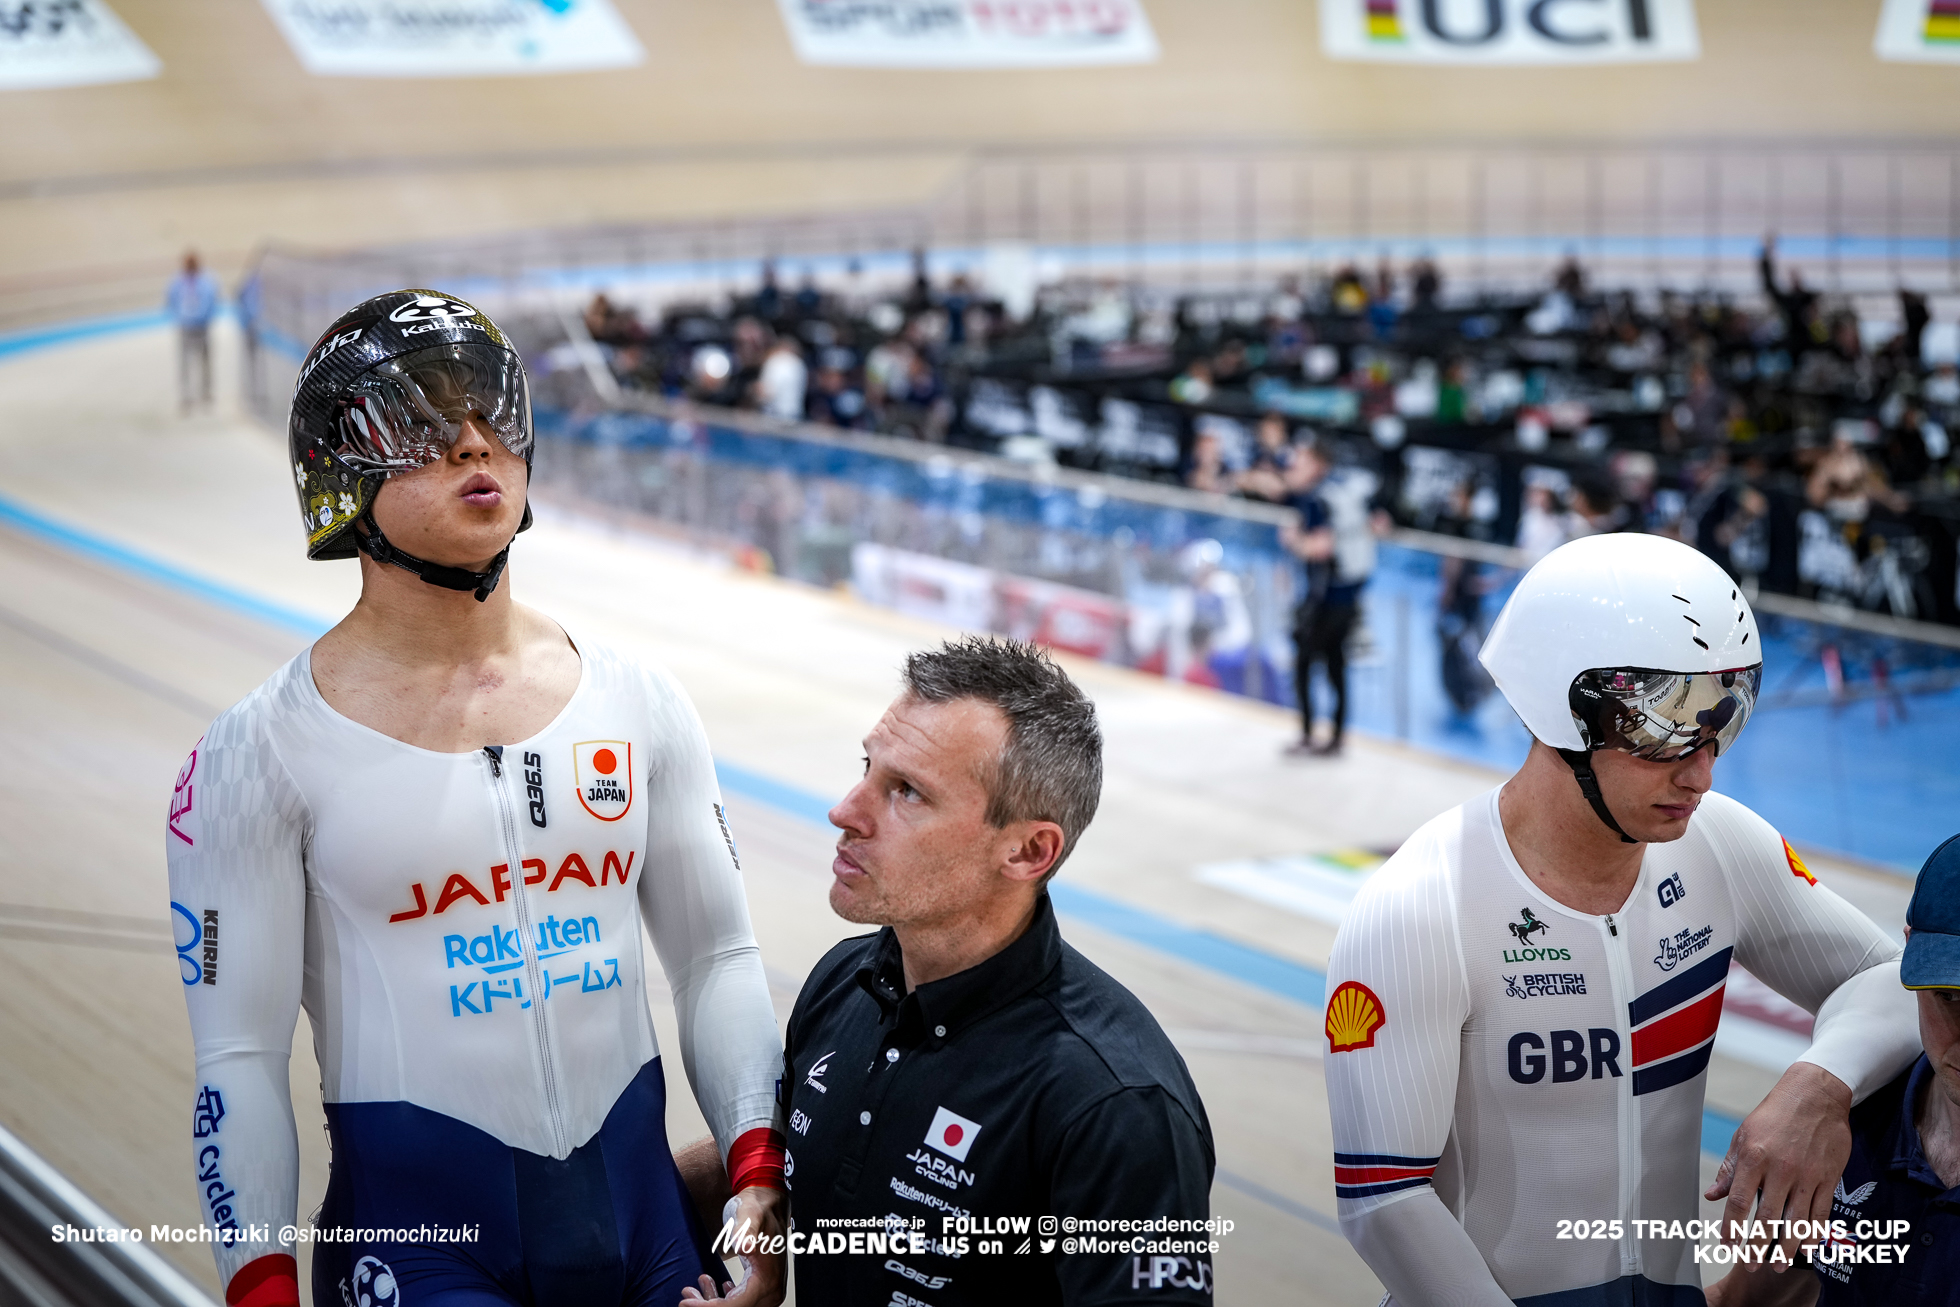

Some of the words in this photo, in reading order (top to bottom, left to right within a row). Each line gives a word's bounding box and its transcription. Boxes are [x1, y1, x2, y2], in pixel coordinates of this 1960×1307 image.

[524, 751, 547, 828] Q36.5
[588, 788, 626, 802] JAPAN
[596, 779, 617, 787] TEAM
[388, 850, 635, 923] JAPAN
[203, 909, 219, 985] KEIRIN
[443, 915, 601, 970] Rakuten
[1674, 927, 1690, 943] THE
[1676, 924, 1713, 952] NATIONAL
[1679, 934, 1711, 961] LOTTERY
[1503, 948, 1571, 963] LLOYDS
[450, 958, 622, 1017] Kドリームス
[1523, 974, 1585, 986] BRITISH
[1527, 984, 1587, 997] CYCLING
[1507, 1027, 1623, 1084] GBR
[906, 1148, 975, 1187] JAPAN
[915, 1165, 958, 1190] CYCLING
[890, 1176, 925, 1203] Rakuten
[1833, 1203, 1862, 1220] STORE
[884, 1259, 948, 1289] Q36.5
[1828, 1267, 1850, 1284] TEAM
